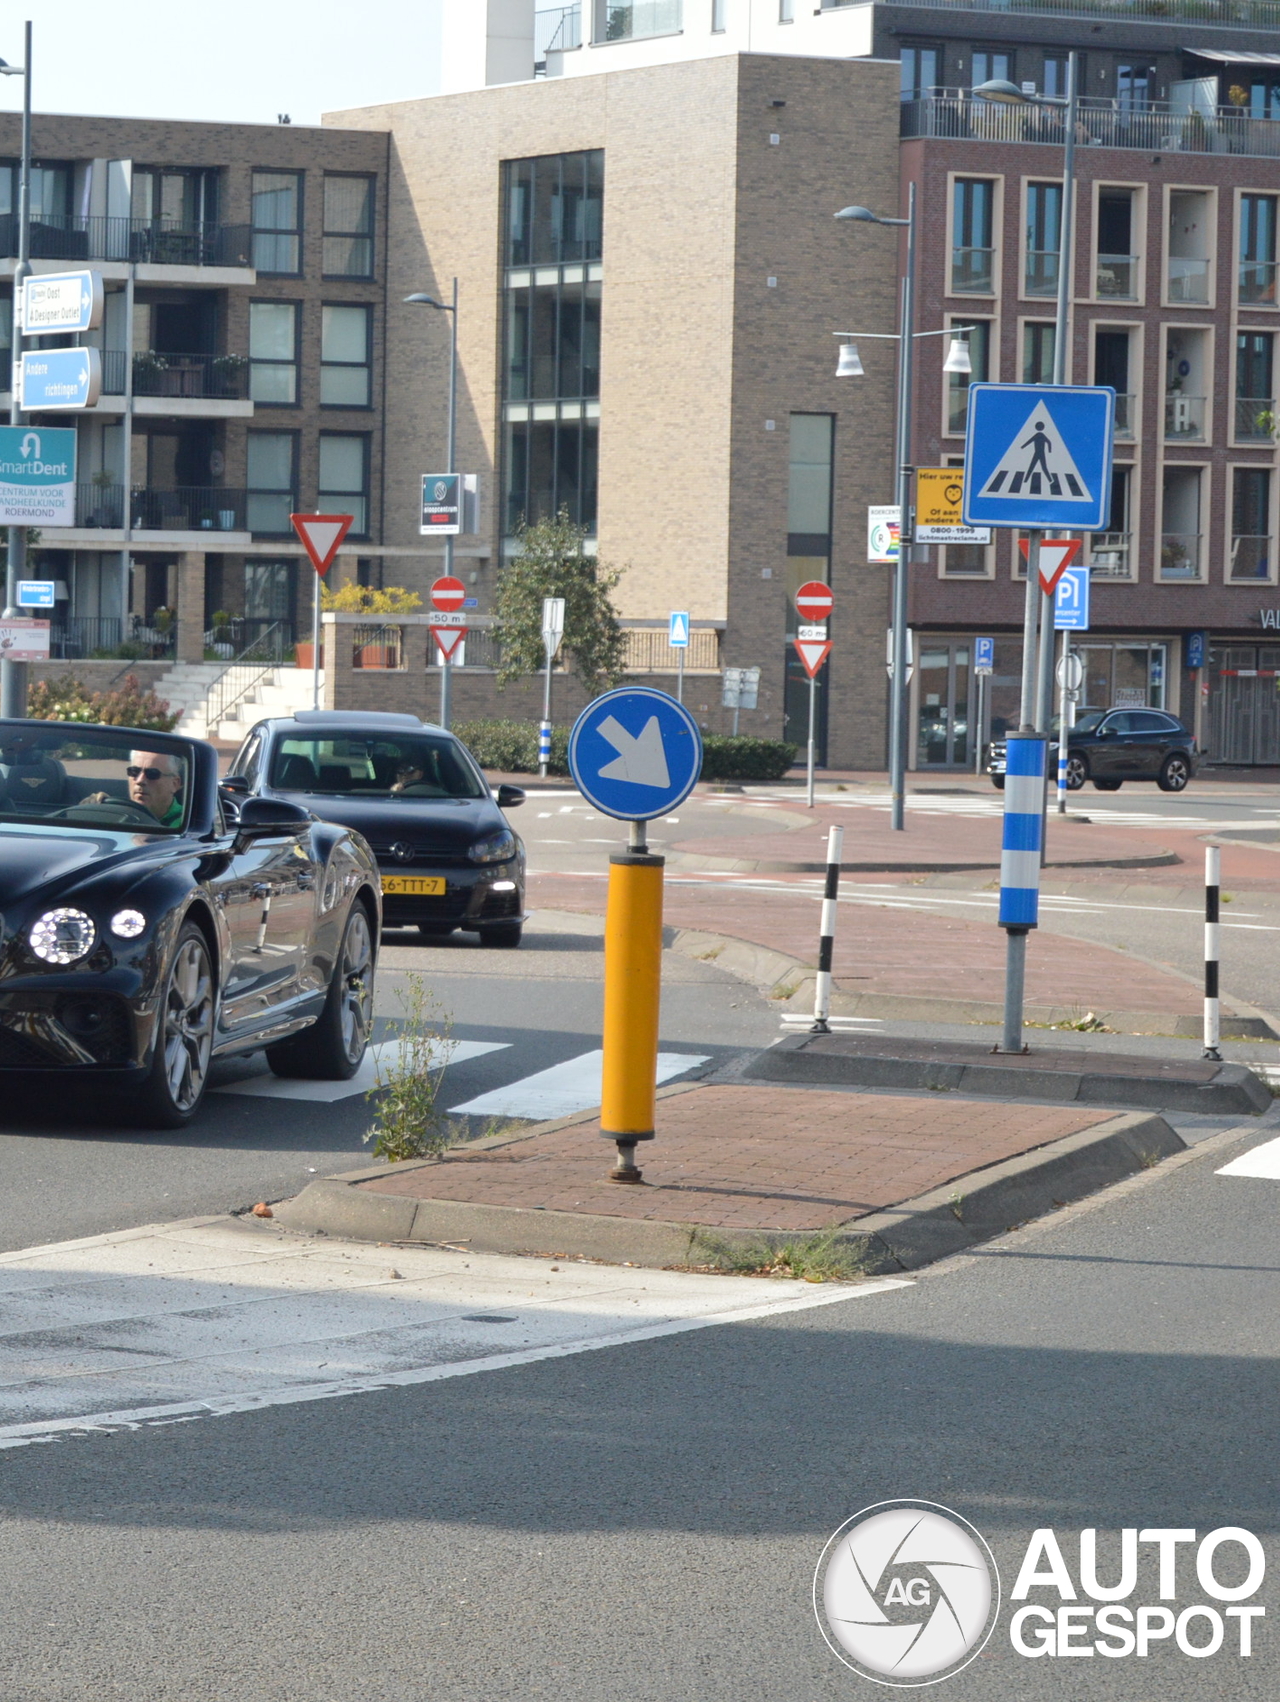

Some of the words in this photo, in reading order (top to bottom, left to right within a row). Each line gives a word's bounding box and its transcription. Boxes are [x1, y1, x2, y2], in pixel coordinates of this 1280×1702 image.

[47, 287, 60, 299] Oost
[35, 309, 60, 324] Designer
[61, 307, 79, 319] Outlet
[27, 363, 48, 375] Andere
[45, 383, 78, 399] richtingen
[40, 488, 64, 497] VOOR
[5, 508, 55, 517] ROERMOND
[434, 614, 448, 622] 50
[980, 640, 990, 655] P
